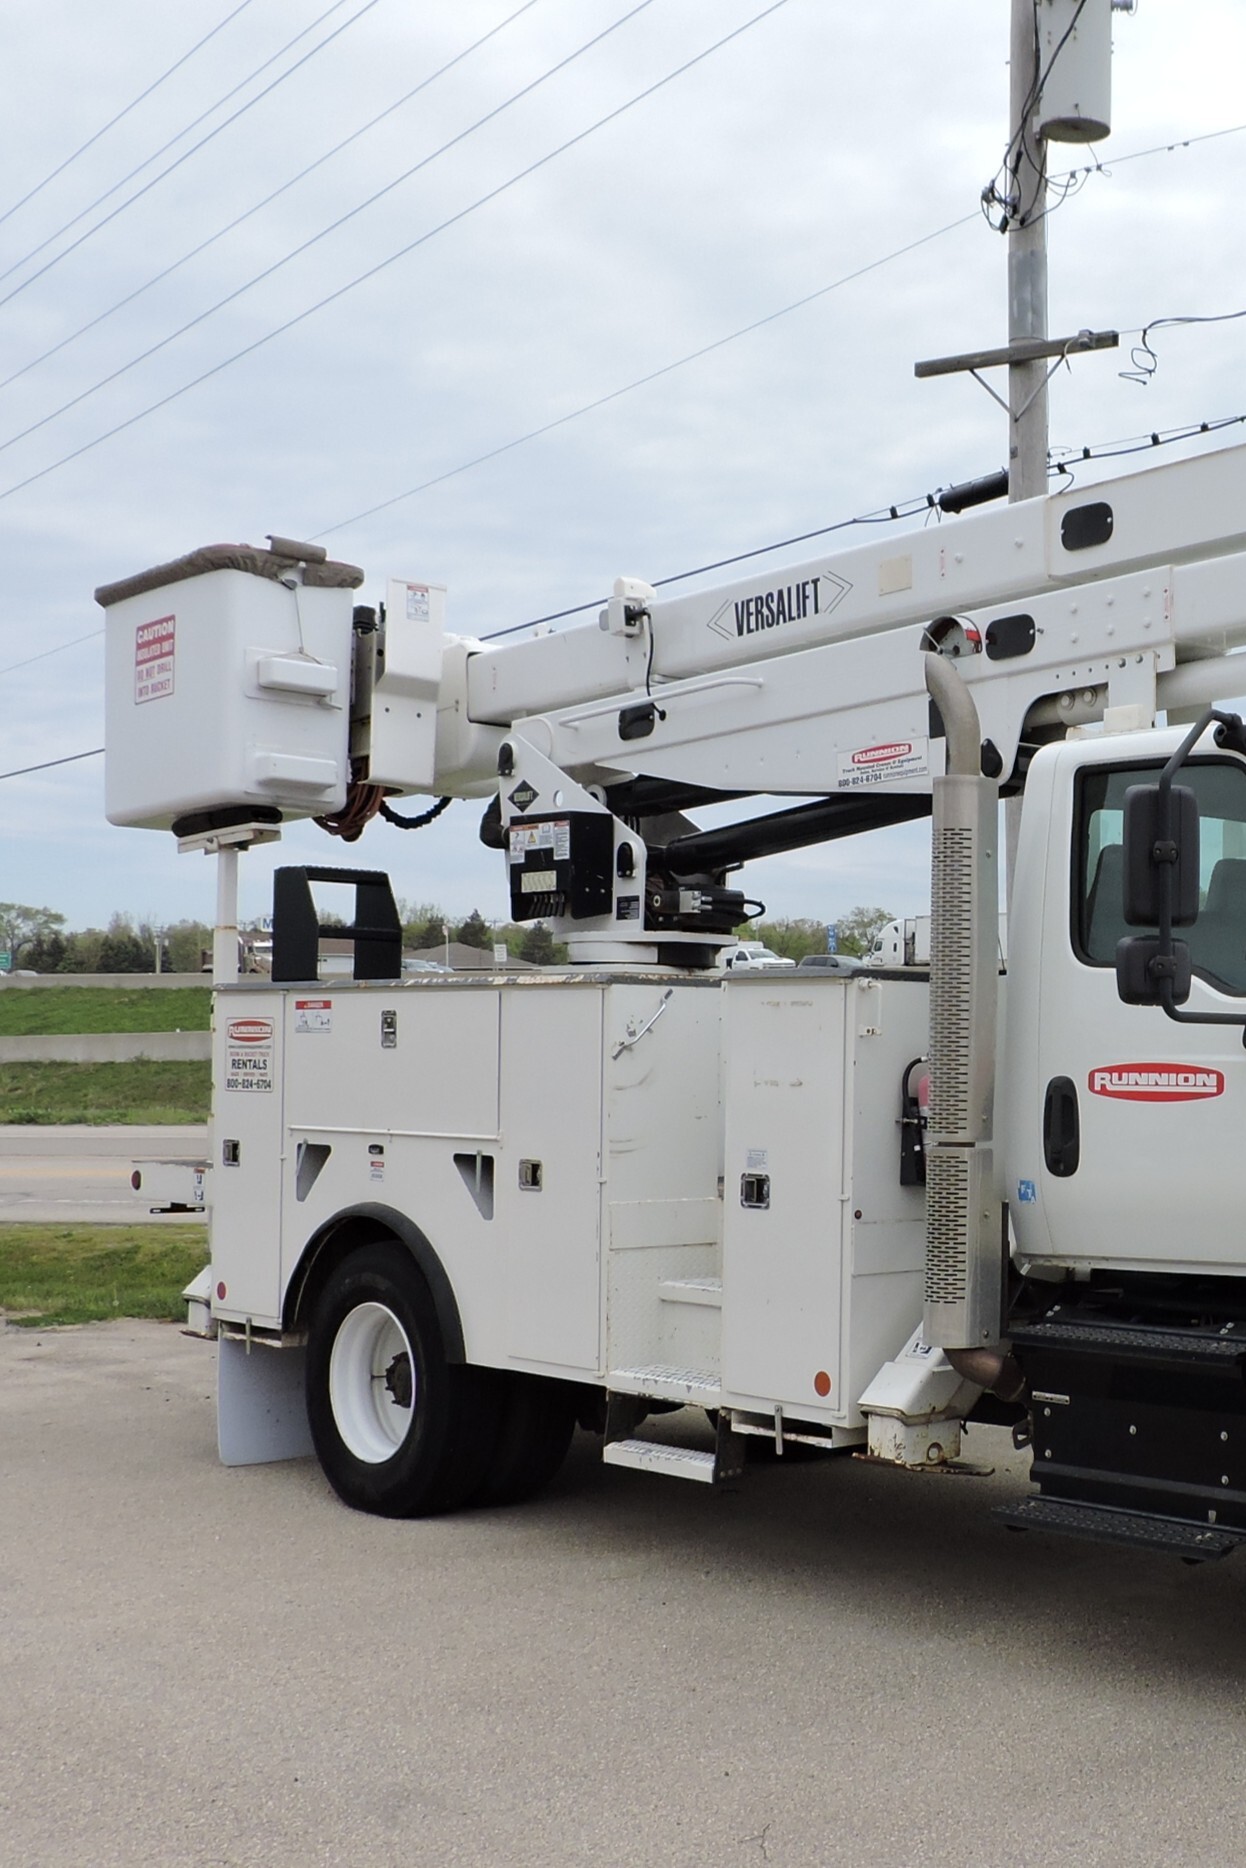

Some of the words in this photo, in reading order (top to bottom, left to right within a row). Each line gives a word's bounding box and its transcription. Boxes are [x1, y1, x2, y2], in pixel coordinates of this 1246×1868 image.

[734, 577, 820, 637] VERSALIFT
[137, 620, 174, 643] CAUTION
[854, 744, 909, 762] RUNNION
[898, 756, 922, 764] Equipment
[231, 1059, 268, 1070] RENTALS
[227, 1078, 272, 1090] 800-824-6704
[1094, 1072, 1217, 1093] RUNNION
